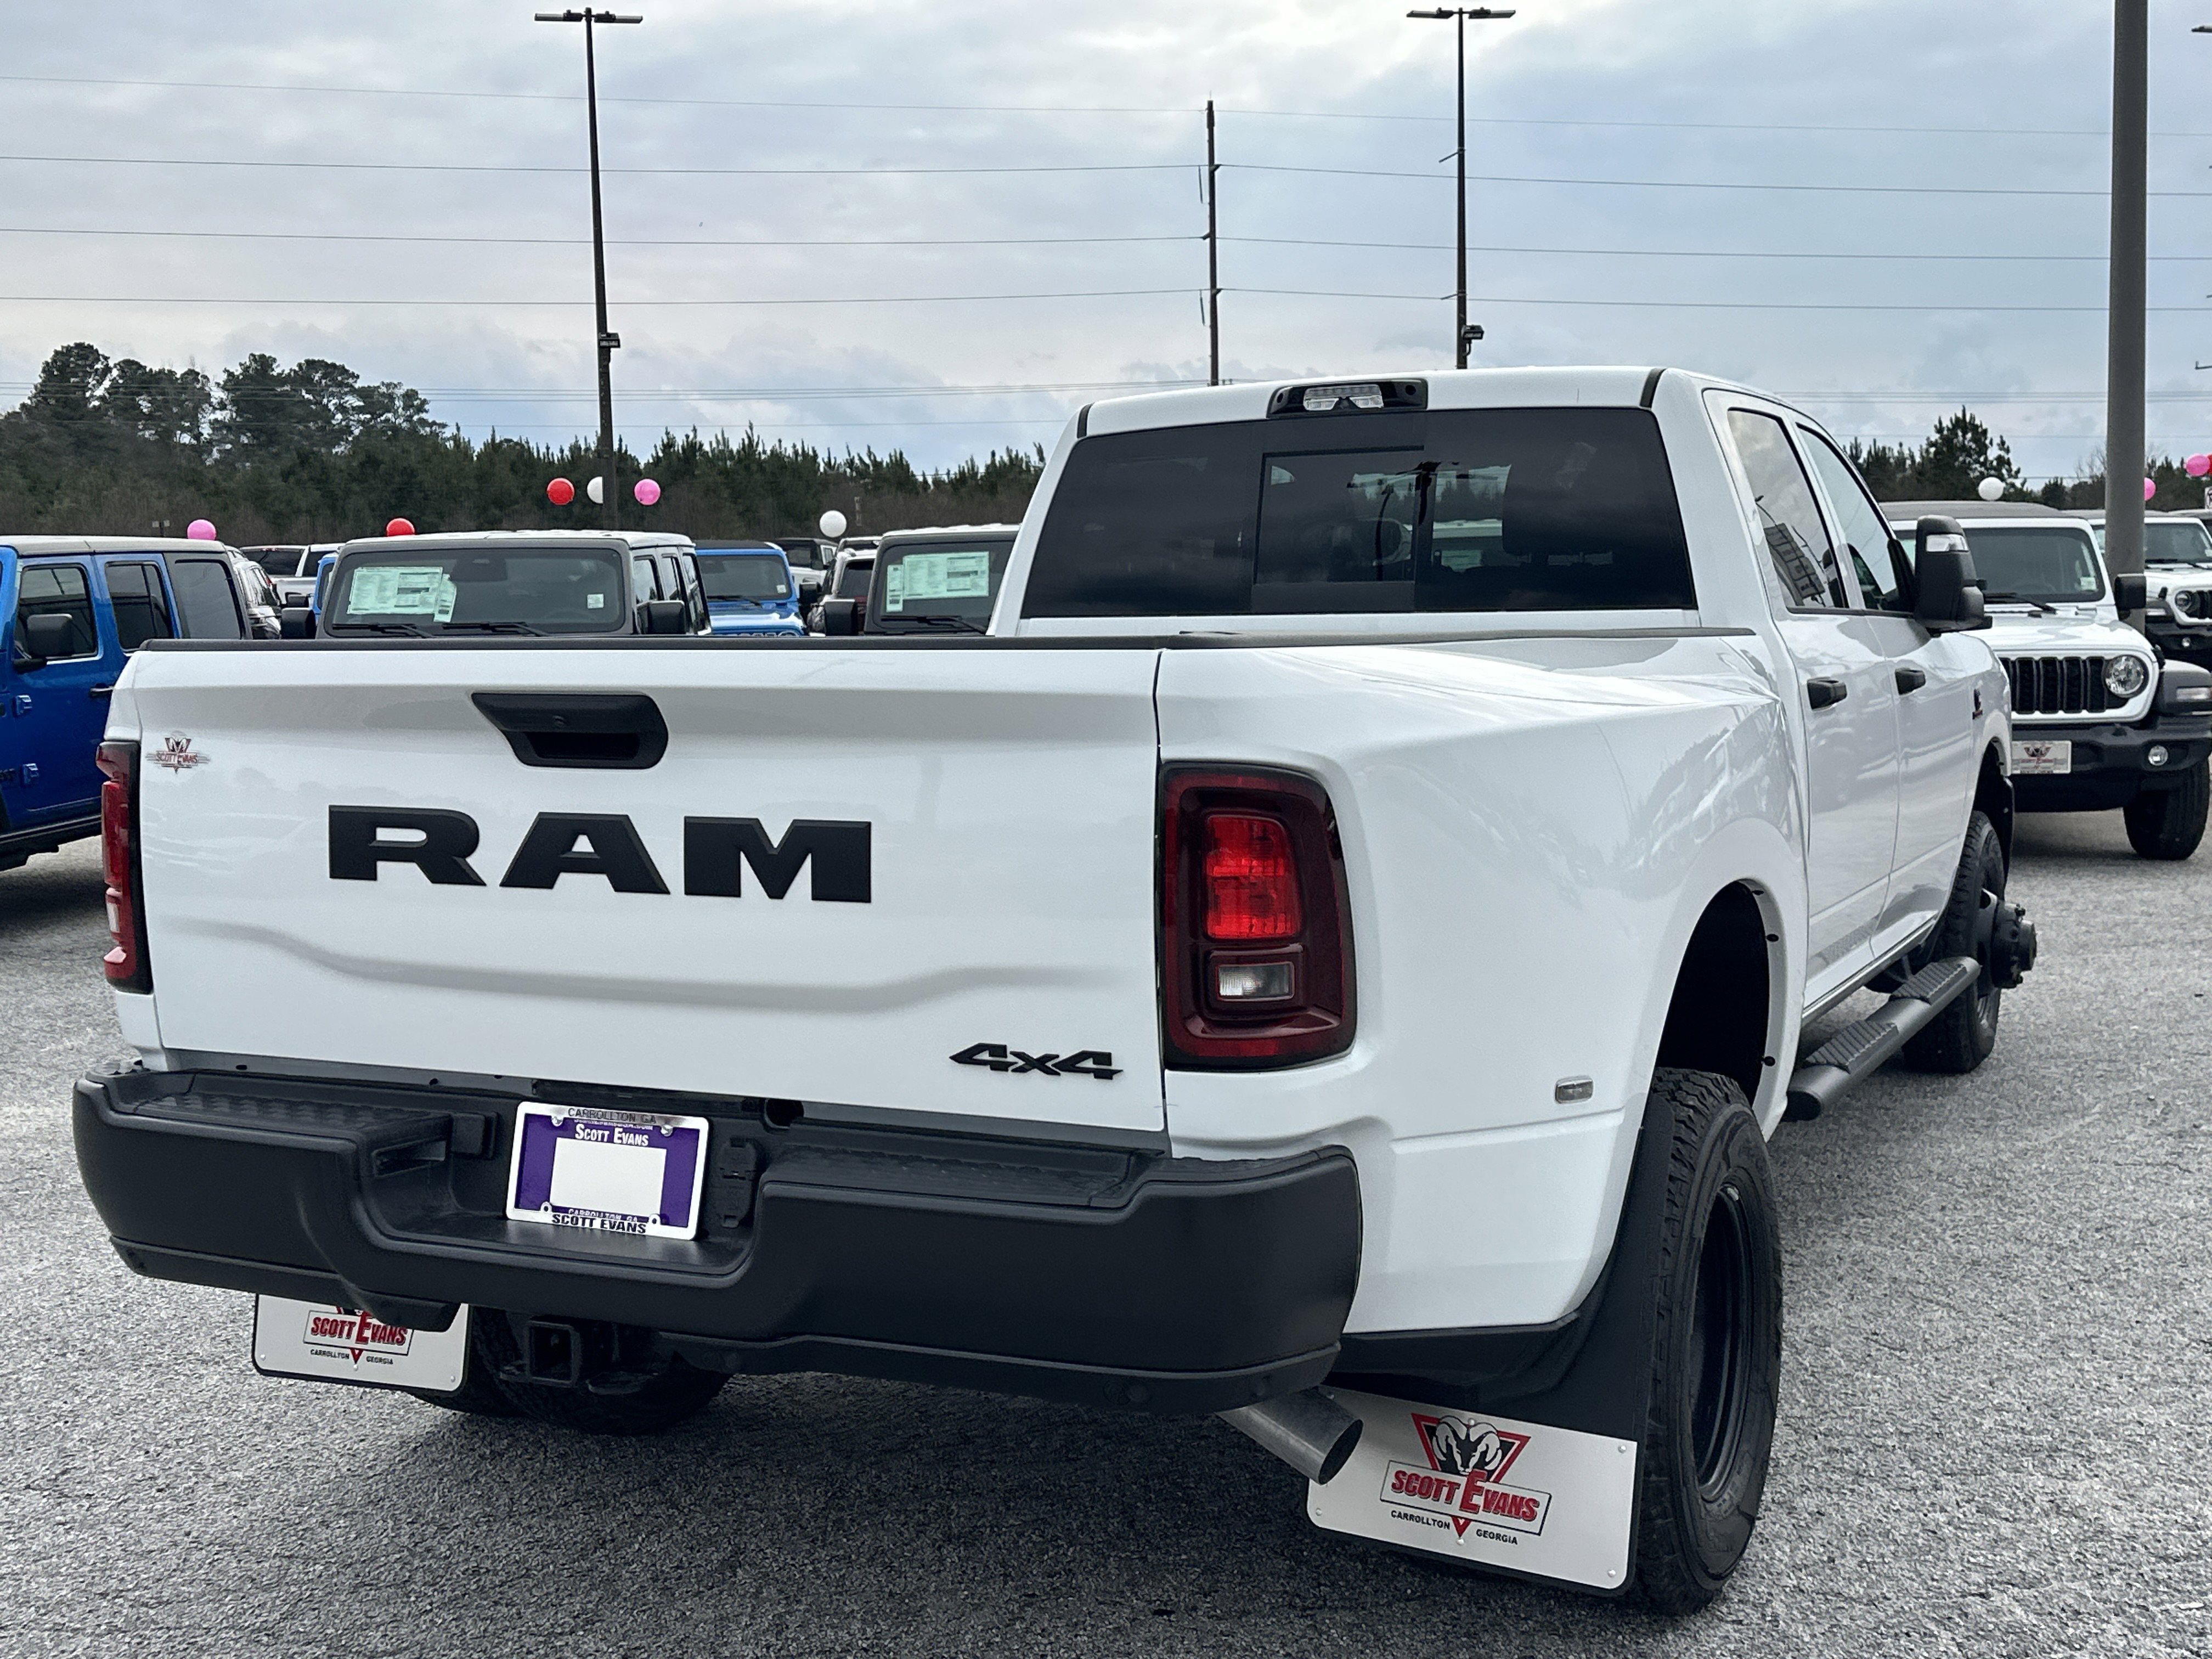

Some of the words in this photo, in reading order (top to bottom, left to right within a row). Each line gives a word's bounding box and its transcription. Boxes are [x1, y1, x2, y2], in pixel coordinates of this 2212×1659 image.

[329, 804, 872, 903] RAM
[949, 1042, 1124, 1080] 4x4
[568, 1107, 636, 1122] CARROLLTON
[641, 1114, 657, 1124] GA
[575, 1123, 610, 1142] SCOTT
[613, 1127, 649, 1146] EVANS
[552, 1214, 596, 1228] SCOTT
[600, 1218, 646, 1234] EVANS
[311, 1317, 357, 1339] SCOTT
[355, 1310, 408, 1346] EVANS
[311, 1348, 350, 1359] CARROLLTON
[366, 1356, 394, 1365] GEORGIA
[1391, 1469, 1461, 1505] SCOTT
[1459, 1468, 1541, 1522] EVANS
[1391, 1510, 1451, 1530] CARROLLTON
[1476, 1528, 1519, 1545] GEORGIA
